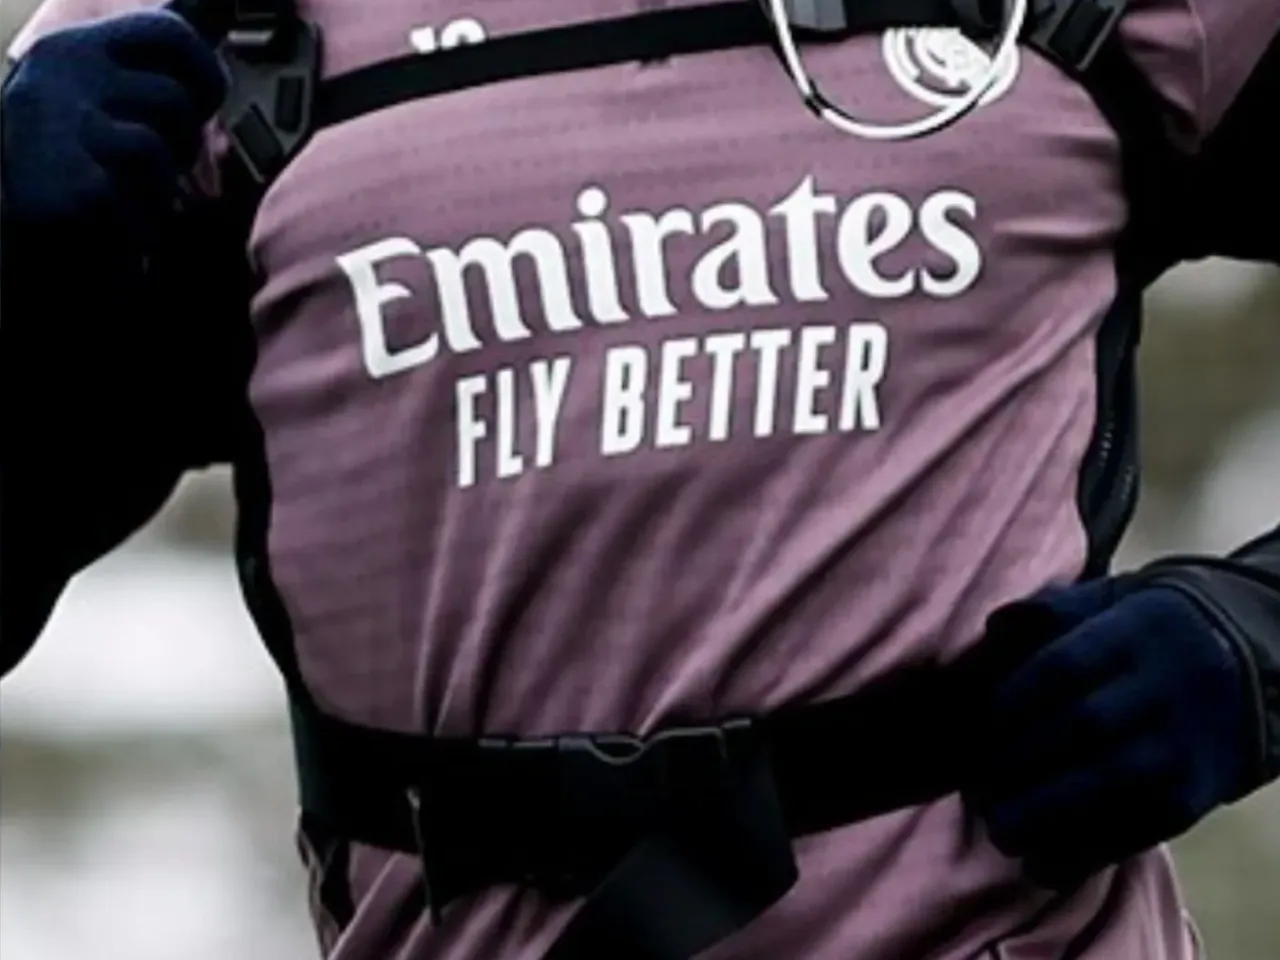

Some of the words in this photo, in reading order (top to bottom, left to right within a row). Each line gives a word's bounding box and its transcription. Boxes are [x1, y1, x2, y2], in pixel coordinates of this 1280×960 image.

[335, 175, 981, 378] Emirates
[454, 357, 572, 487] FLY
[601, 323, 888, 455] BETTER
